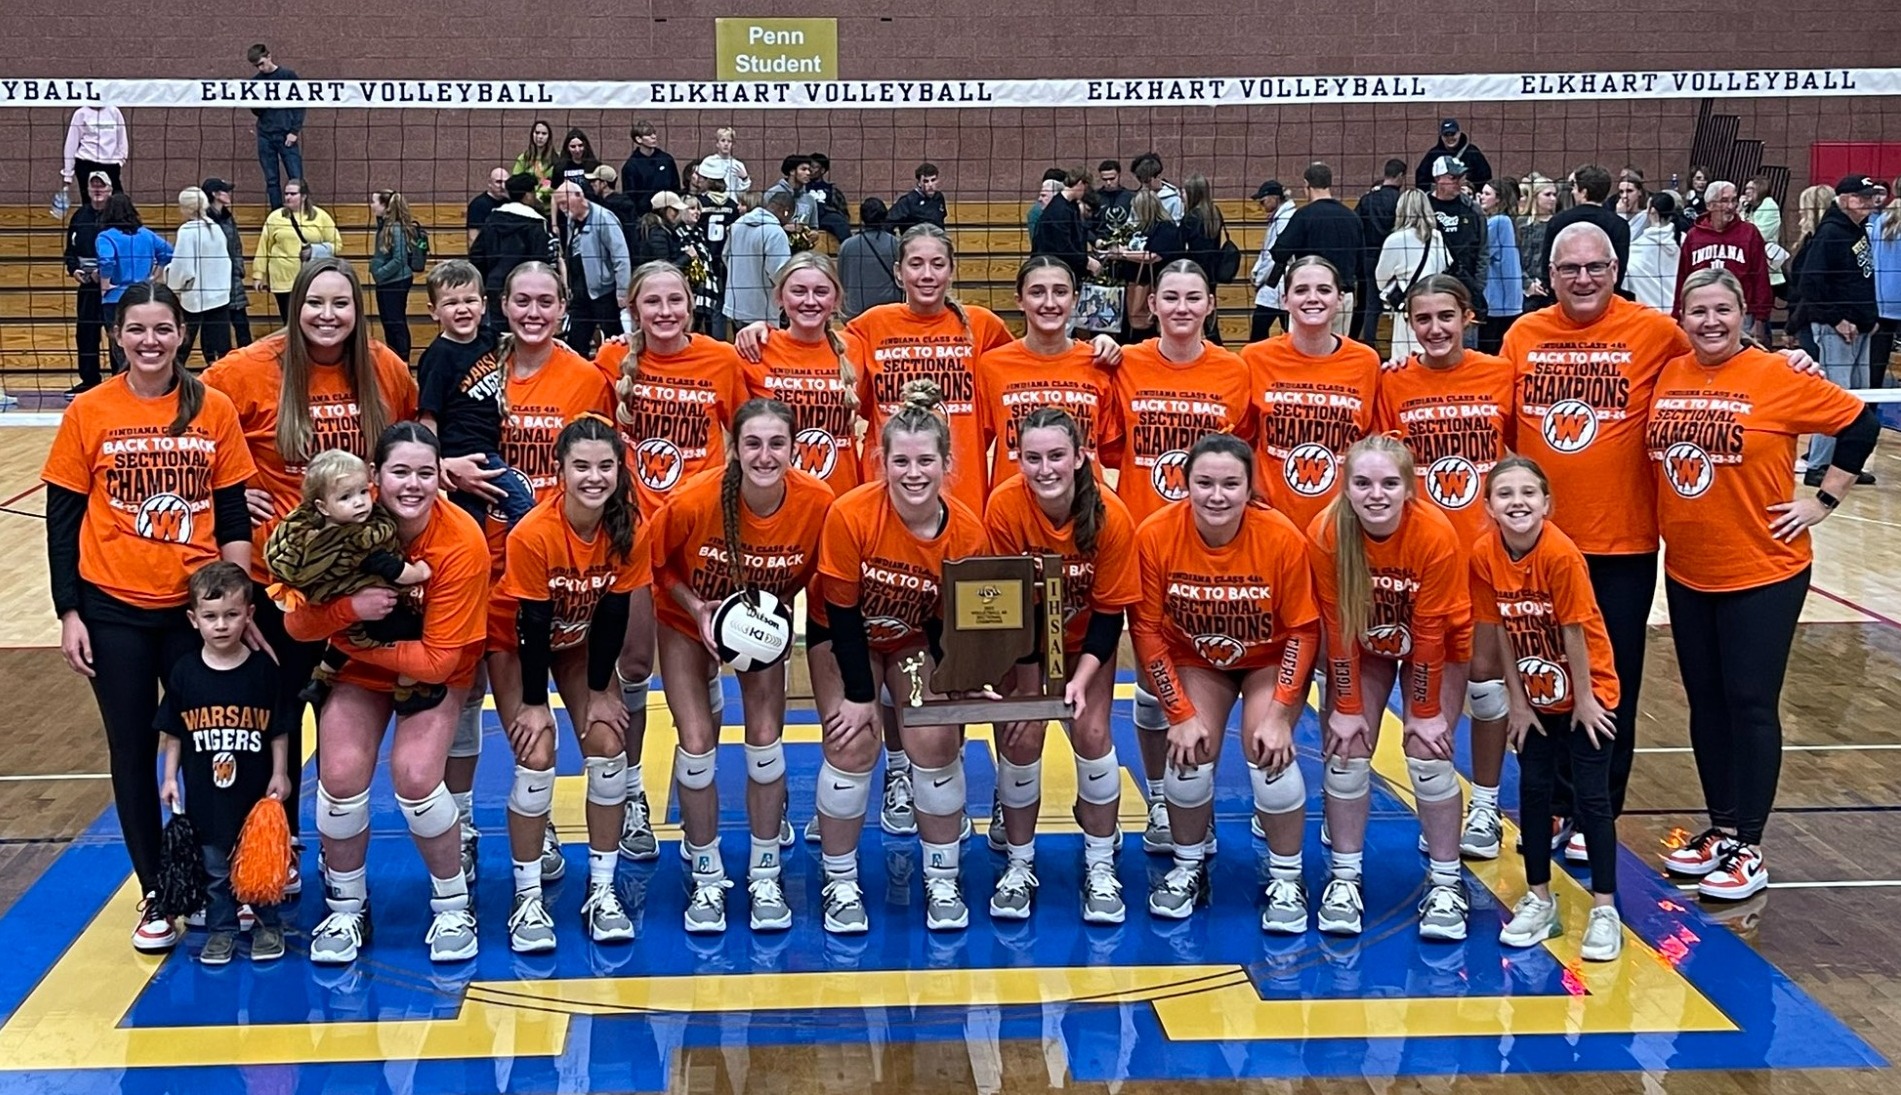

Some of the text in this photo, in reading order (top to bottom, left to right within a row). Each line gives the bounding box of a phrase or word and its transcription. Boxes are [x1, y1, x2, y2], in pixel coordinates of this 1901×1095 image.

[749, 26, 804, 45] Penn
[735, 54, 822, 73] Student
[1, 81, 101, 100] YBALL
[202, 81, 553, 102] ELKHART VOLLEYBALL
[650, 82, 993, 102] ELKHART VOLLEYBALL
[1087, 77, 1426, 100] ELKHART VOLLEYBALL
[1520, 71, 1856, 94] ELKHART VOLLEYBALL
[708, 214, 725, 241] 6
[1692, 244, 1746, 266] INDIANA
[874, 345, 973, 360] BACK TO BACK
[1527, 351, 1632, 363] BACK TO BACK
[459, 352, 498, 393] WARS
[883, 358, 965, 373] SECTIONAL
[1534, 362, 1621, 377] SECTIONAL
[633, 384, 717, 404] CK TO BACK
[764, 376, 802, 389] BACK
[805, 378, 826, 391] TO
[874, 372, 973, 402] CHAONS
[1523, 374, 1630, 408] CHAMPIONS
[631, 397, 706, 418] ECTIONAL
[773, 388, 846, 407] SECTION
[1002, 390, 1098, 406] BACK TO BACK
[1264, 391, 1363, 411] BACK TO BACK
[1654, 399, 1754, 415] BACK TO BACK
[325, 403, 346, 418] TO
[1131, 400, 1228, 417] BACK TO BACK
[1273, 403, 1354, 424] SECTIONAL
[1400, 404, 1499, 423] BACK TO BACK
[1655, 408, 1737, 423] SECTIONAL
[313, 416, 362, 434] CTION
[524, 415, 565, 429] BACK
[1138, 411, 1219, 429] SECTIONAL
[1408, 417, 1493, 436] SECTIONAL
[1553, 413, 1591, 442] W
[501, 428, 554, 444] TIONAL
[634, 413, 712, 449] AMPIONS
[1265, 415, 1361, 453] CHAMPIONS
[1647, 420, 1745, 454] CHAMPIONS
[102, 437, 217, 454] BACK TO BACK
[114, 450, 209, 469] SECTIONAL
[641, 451, 676, 482] W
[797, 443, 830, 472] W
[1294, 457, 1329, 486] W
[1669, 457, 1704, 487] W
[105, 466, 213, 504] CHAMPIONS
[1434, 471, 1470, 498] W
[149, 510, 186, 540] W
[698, 546, 804, 568] BAC TO BACK
[1069, 562, 1094, 577] BAC
[548, 576, 574, 592] ACK
[863, 577, 920, 604] SECTIO
[899, 573, 919, 589] TO
[922, 579, 938, 596] BA
[1168, 583, 1271, 600] ACK TO BACK
[1371, 576, 1392, 590] TO
[1168, 596, 1263, 616] SECTIONAL
[1515, 601, 1534, 615] TO
[745, 606, 781, 631] Wilson
[1048, 581, 1063, 675] IHSAA
[1280, 637, 1300, 686] TIGERS
[1151, 659, 1180, 707] TIGERS
[1336, 658, 1351, 698] TIGER
[1522, 672, 1556, 698] W
[181, 705, 271, 732] WARSAW
[193, 728, 262, 753] TIGERS
